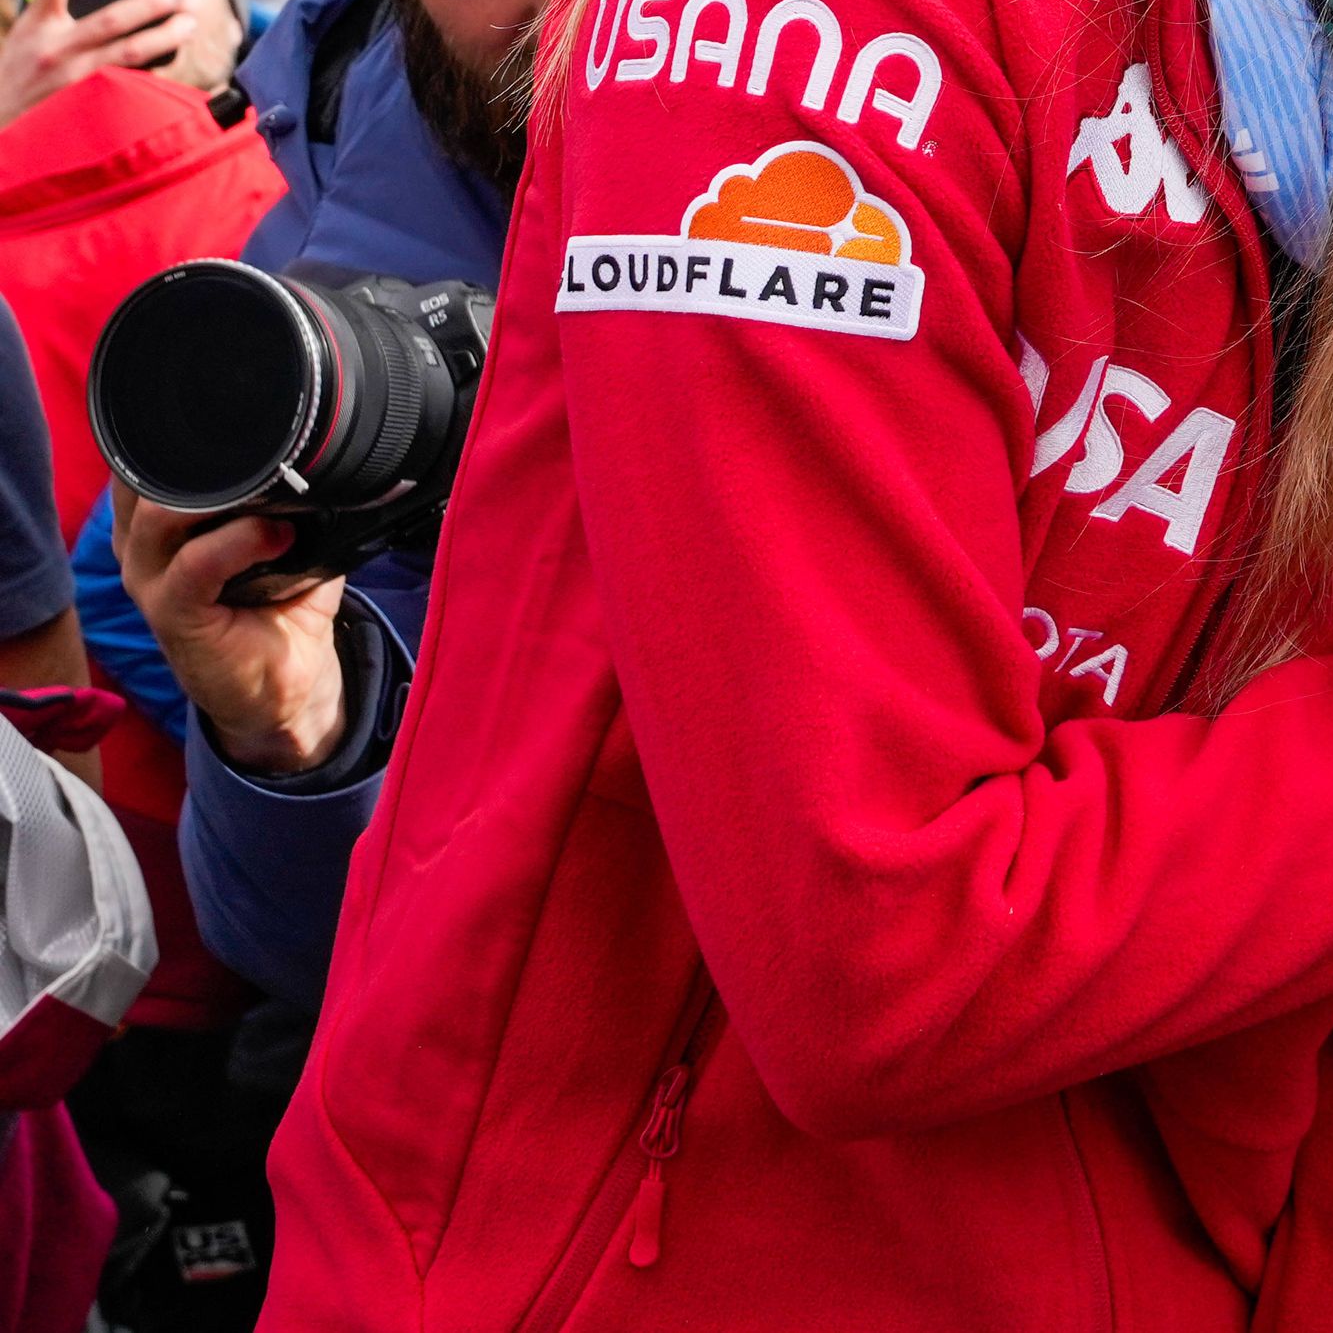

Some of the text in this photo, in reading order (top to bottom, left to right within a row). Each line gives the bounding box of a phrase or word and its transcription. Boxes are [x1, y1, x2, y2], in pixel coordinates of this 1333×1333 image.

[559, 254, 896, 320] LOUDFLARE
[420, 292, 450, 313] EOS
[428, 309, 448, 328] R5
